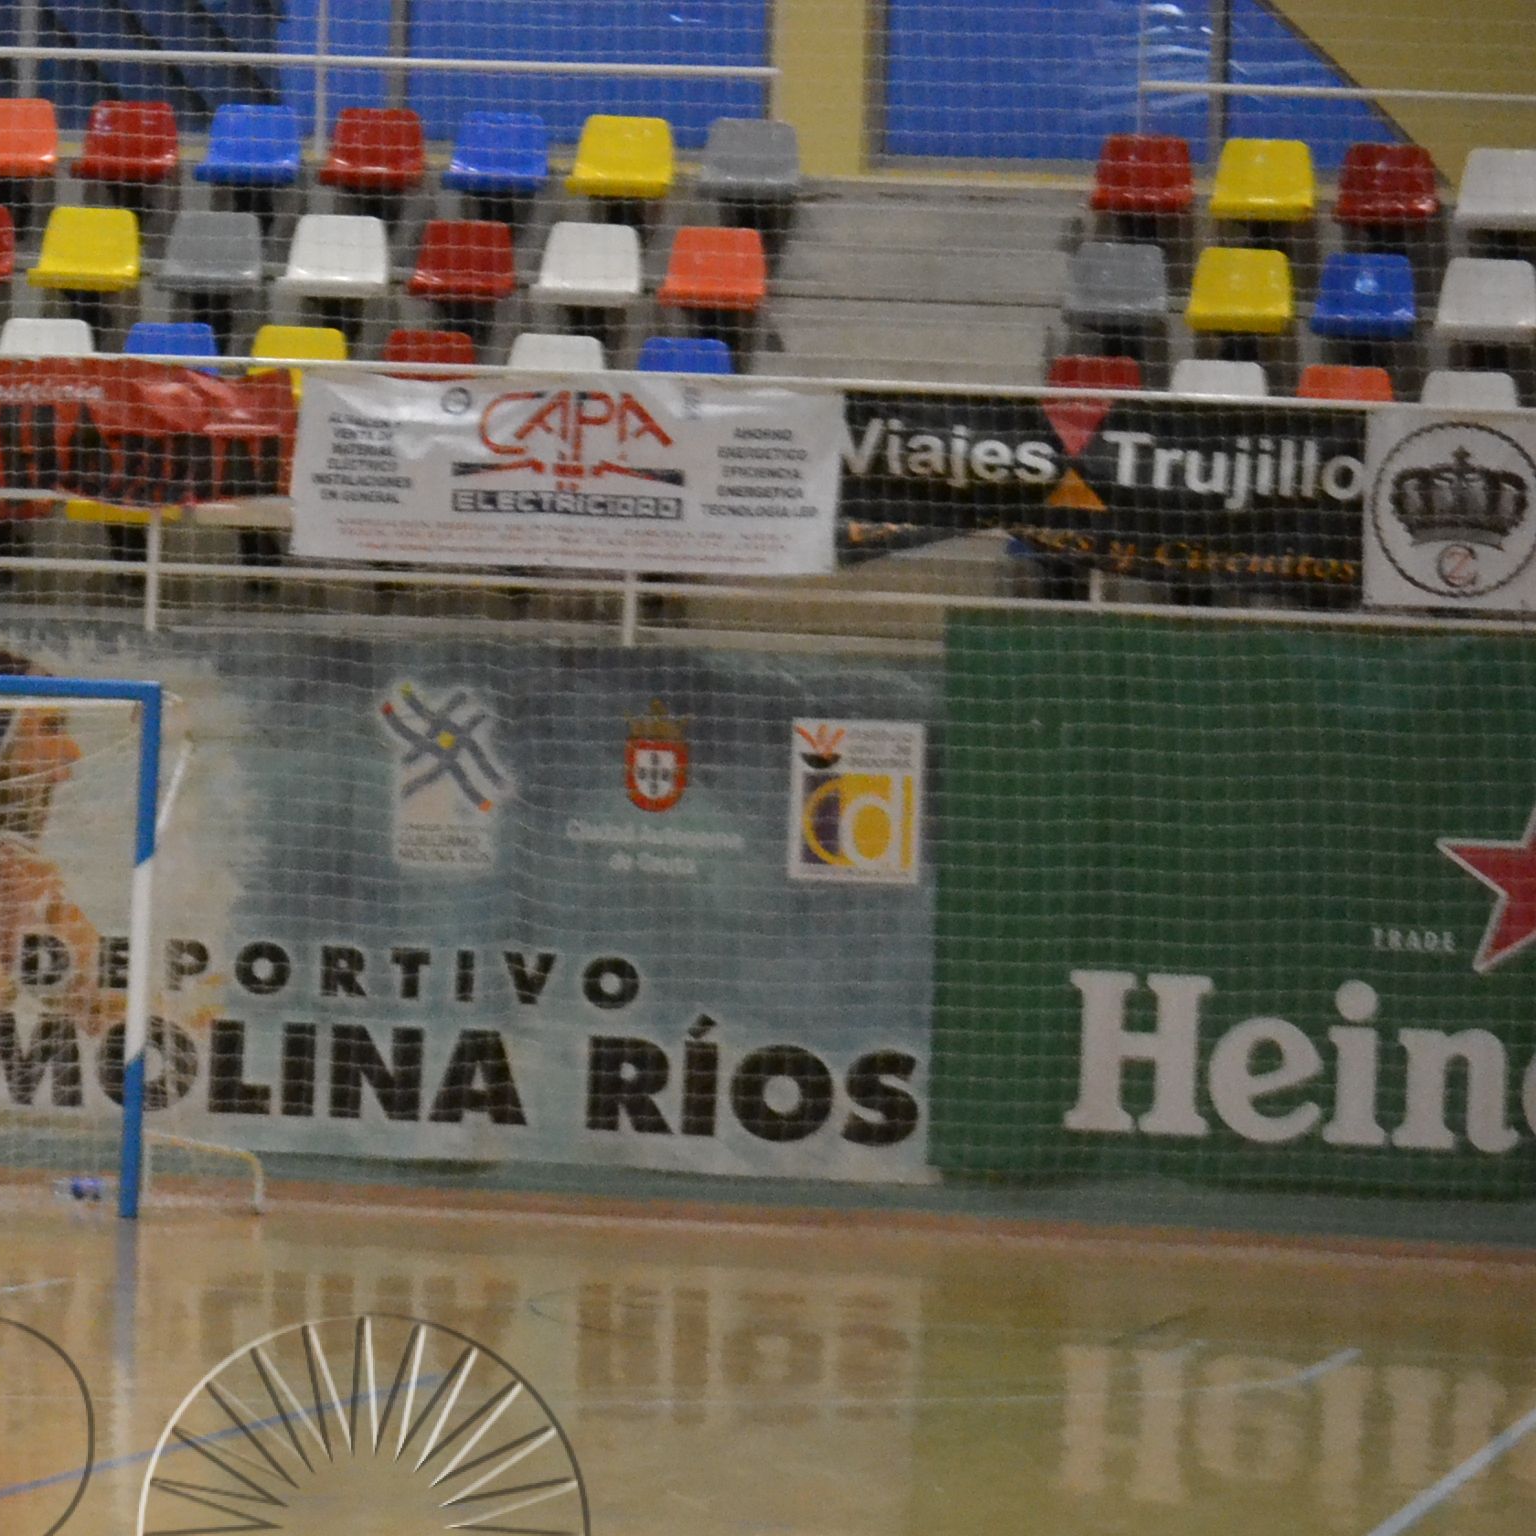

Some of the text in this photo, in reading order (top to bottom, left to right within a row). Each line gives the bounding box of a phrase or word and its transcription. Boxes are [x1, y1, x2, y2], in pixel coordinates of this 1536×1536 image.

[480, 388, 673, 461] CAPA
[839, 417, 1363, 510] Viajes Trujillo
[1371, 926, 1456, 954] TRADE
[585, 1013, 920, 1147] RÍOS
[1063, 969, 1536, 1153] Hein
